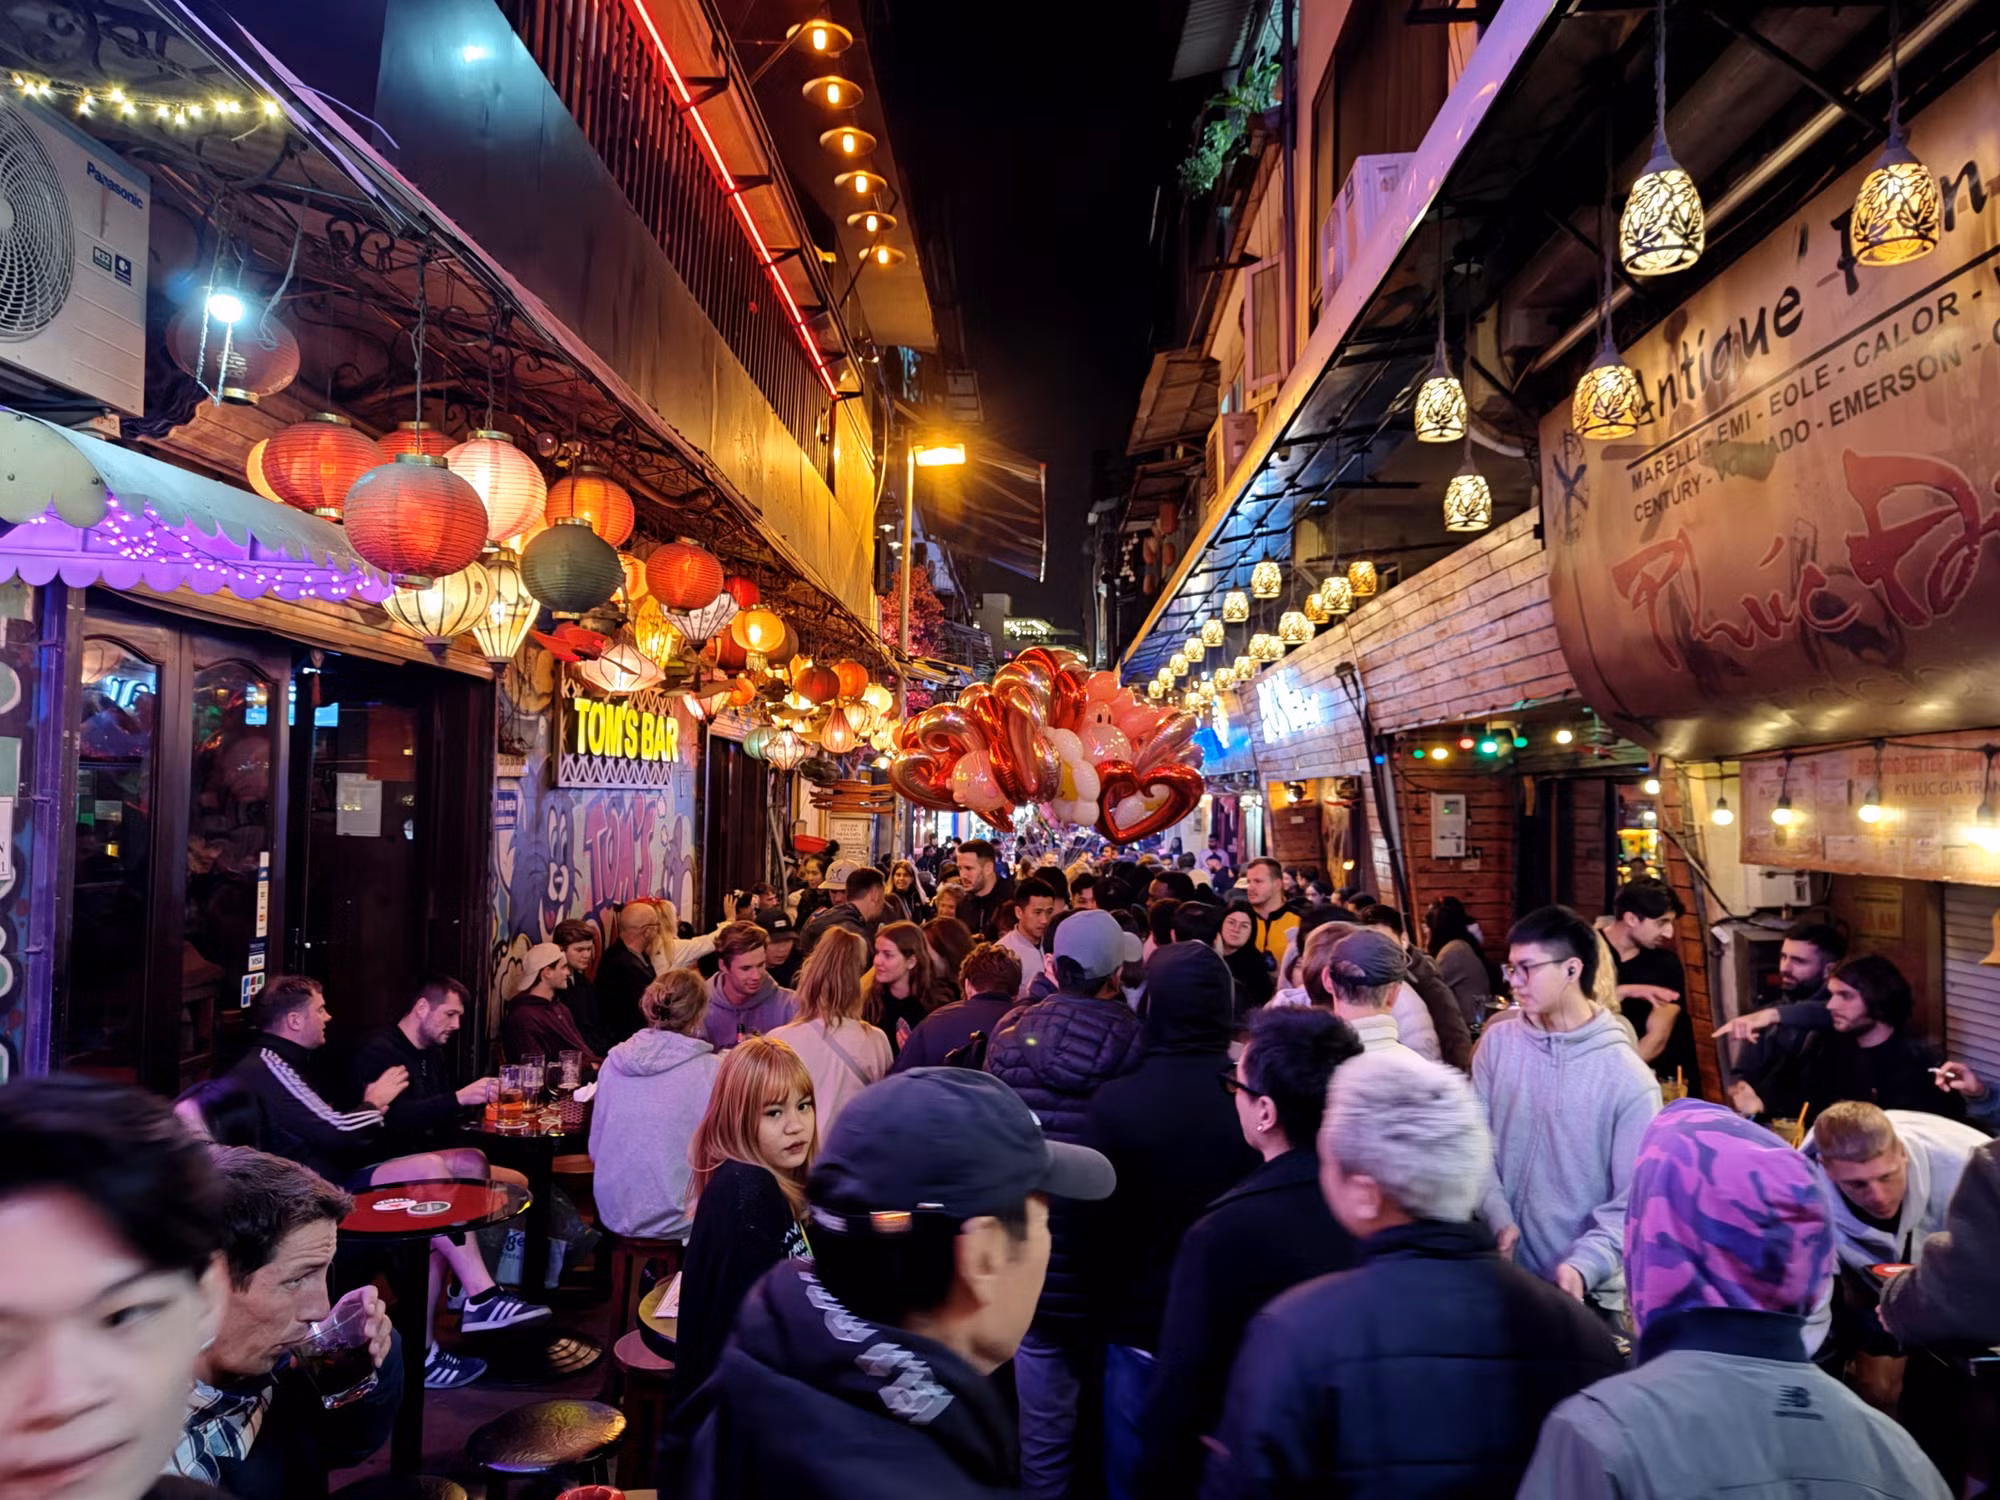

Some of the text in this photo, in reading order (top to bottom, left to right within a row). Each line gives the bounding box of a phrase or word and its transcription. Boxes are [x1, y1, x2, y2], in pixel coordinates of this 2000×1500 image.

[86, 160, 144, 210] Panasonic
[1631, 438, 1700, 493] MARELLI
[1717, 409, 1751, 447] EMI
[1769, 363, 1831, 417] EOLE
[1853, 291, 1960, 369] CALOR
[1633, 473, 1702, 523] CENTURY
[1828, 340, 1962, 428] EMERSON
[574, 696, 680, 763] TOM'S BAR
[584, 789, 657, 906] TOM'S
